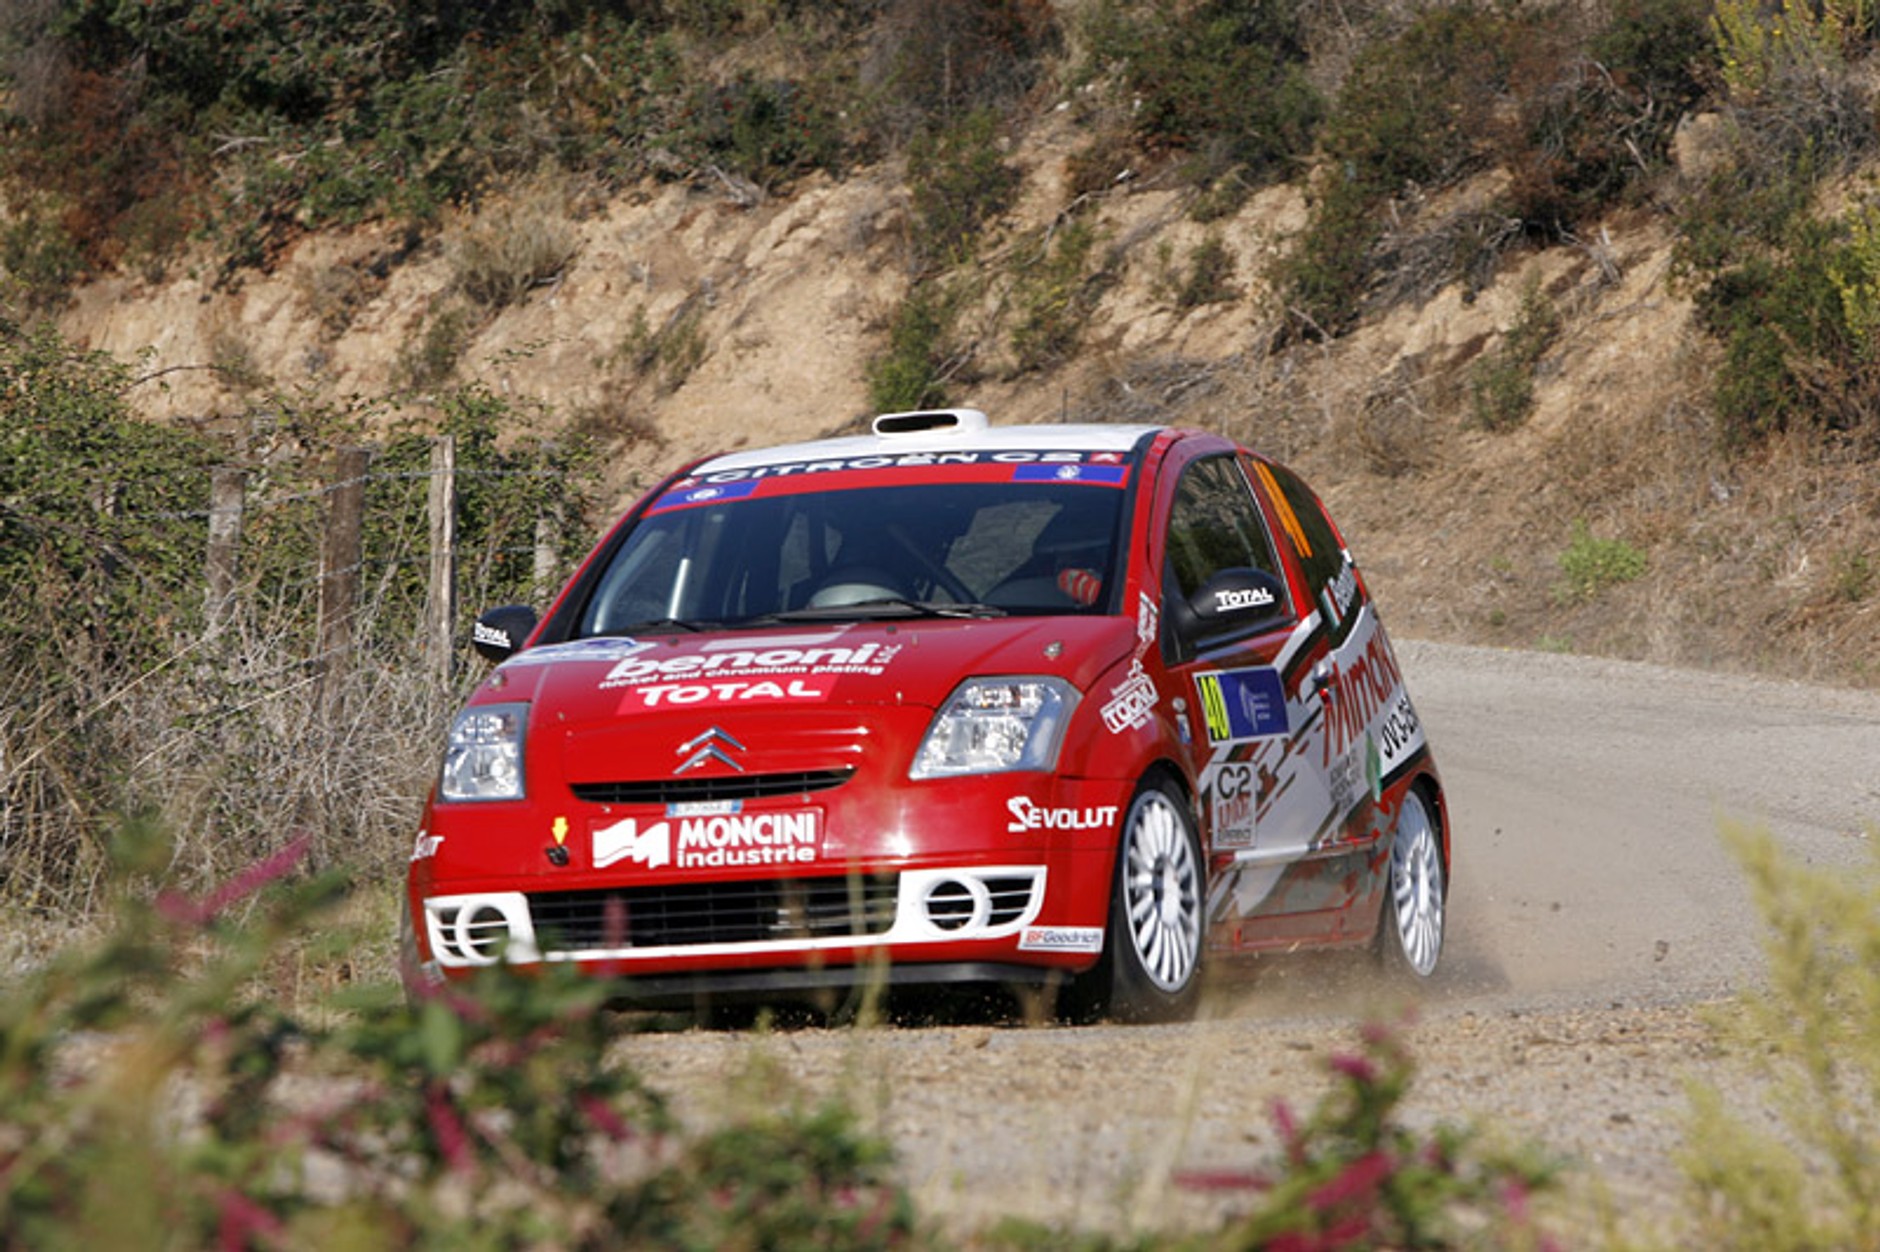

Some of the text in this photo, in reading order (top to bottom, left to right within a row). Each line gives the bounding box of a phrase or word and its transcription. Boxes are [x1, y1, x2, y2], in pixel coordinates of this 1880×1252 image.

[991, 452, 1083, 463] C2
[1215, 587, 1274, 610] TOTAL
[474, 622, 511, 647] TOTAL
[606, 643, 880, 681] benoni
[599, 663, 884, 690] nickel and chromium plating
[636, 680, 821, 706] TOTAL
[1217, 765, 1252, 800] C2
[1006, 796, 1119, 833] SEVOLUT
[676, 813, 815, 850] MONCINI
[676, 846, 816, 868] industrie
